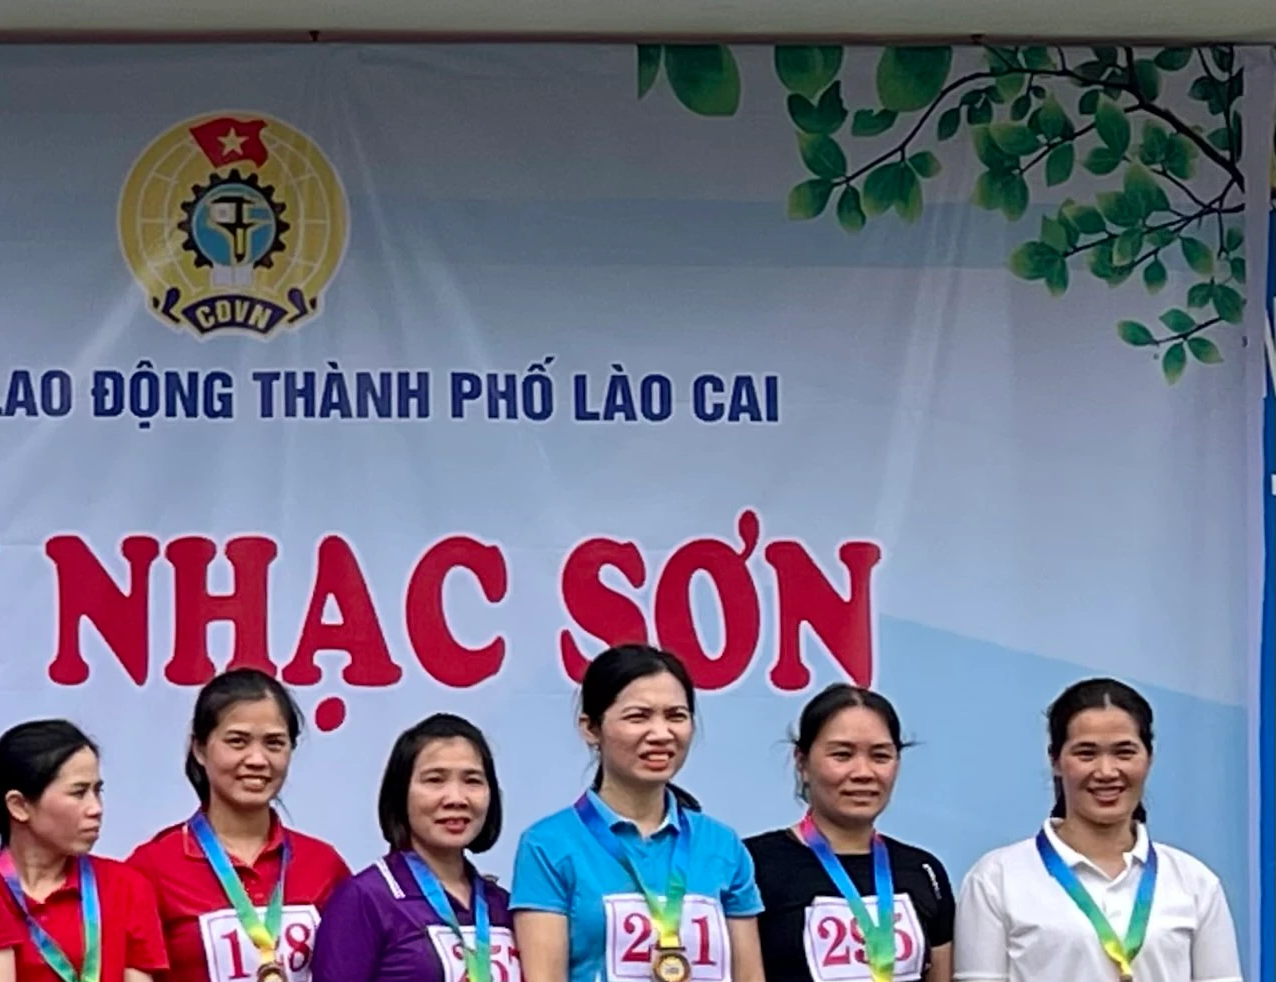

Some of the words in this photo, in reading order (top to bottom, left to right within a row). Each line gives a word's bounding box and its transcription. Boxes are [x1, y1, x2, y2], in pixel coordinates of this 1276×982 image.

[92, 360, 234, 429] ĐỘNG
[252, 361, 431, 419] THÀNH
[450, 356, 555, 421] PHỐ
[574, 363, 672, 422] LÀO
[693, 374, 779, 422] CAI
[46, 535, 507, 732] NHẠC
[560, 509, 882, 690] SƠN
[221, 923, 311, 980] 18
[621, 913, 717, 966] 21
